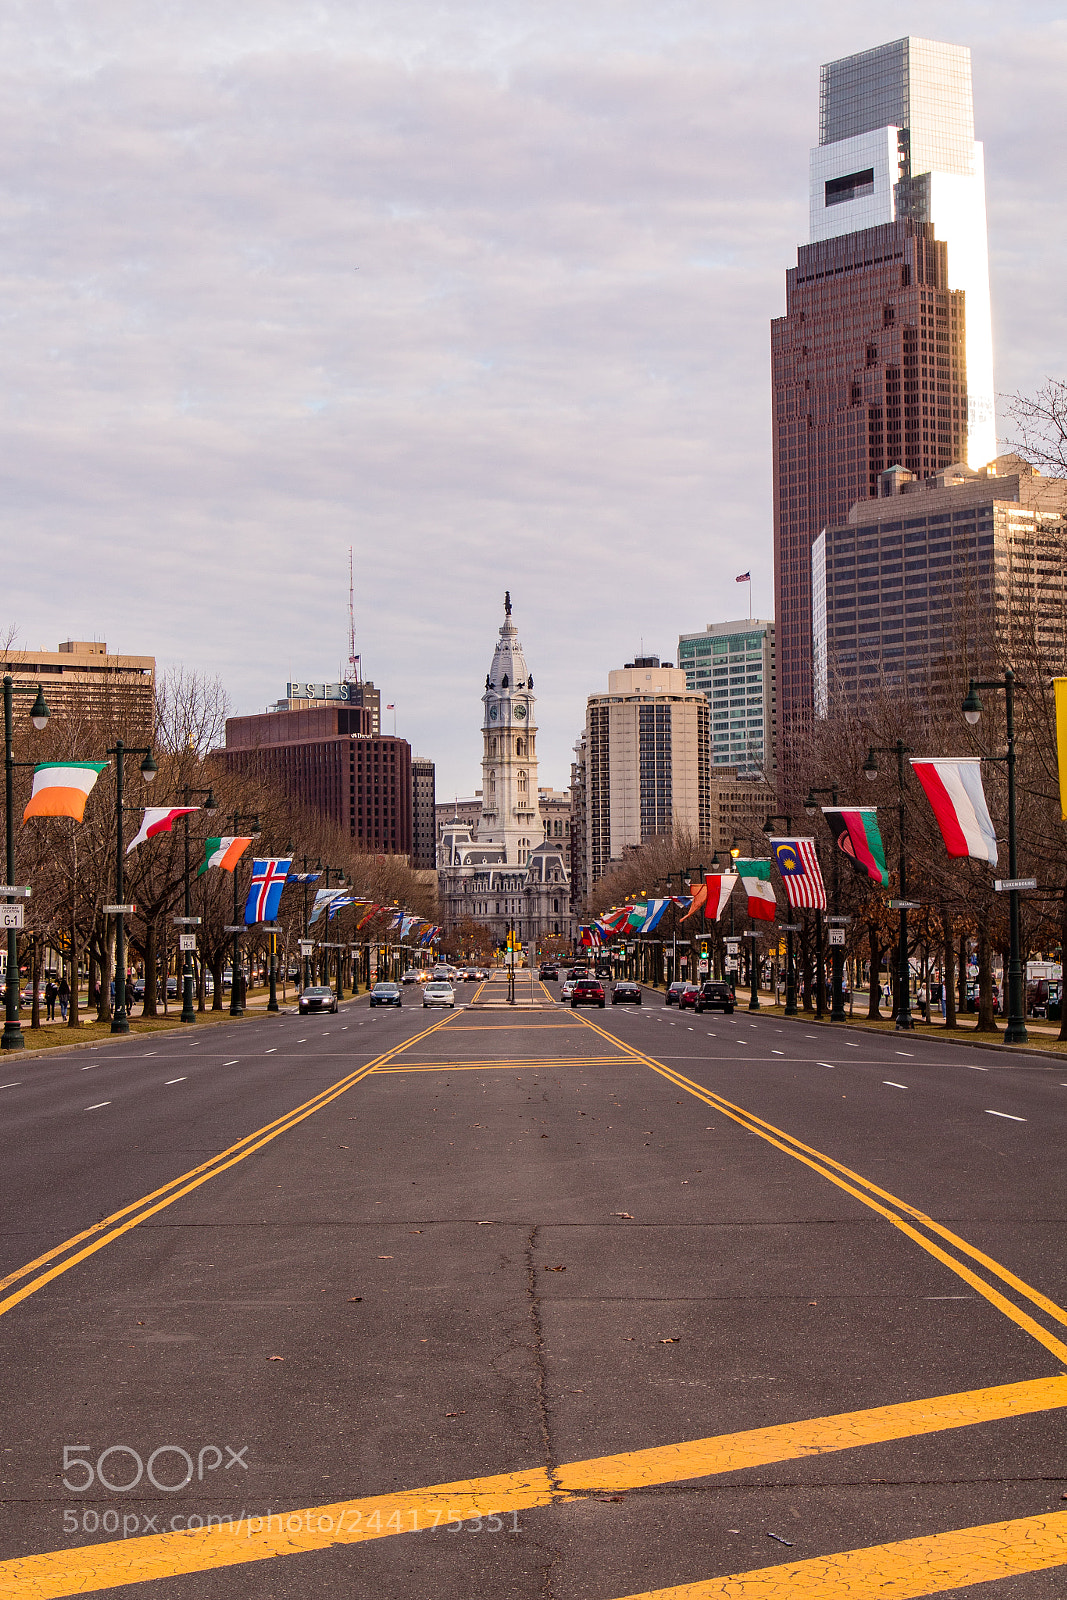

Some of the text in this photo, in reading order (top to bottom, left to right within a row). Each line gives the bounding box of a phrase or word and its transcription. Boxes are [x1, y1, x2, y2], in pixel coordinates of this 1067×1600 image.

[291, 682, 348, 700] PSFS
[4, 914, 18, 926] G-1
[832, 935, 843, 943] H-2
[183, 941, 193, 949] H-1
